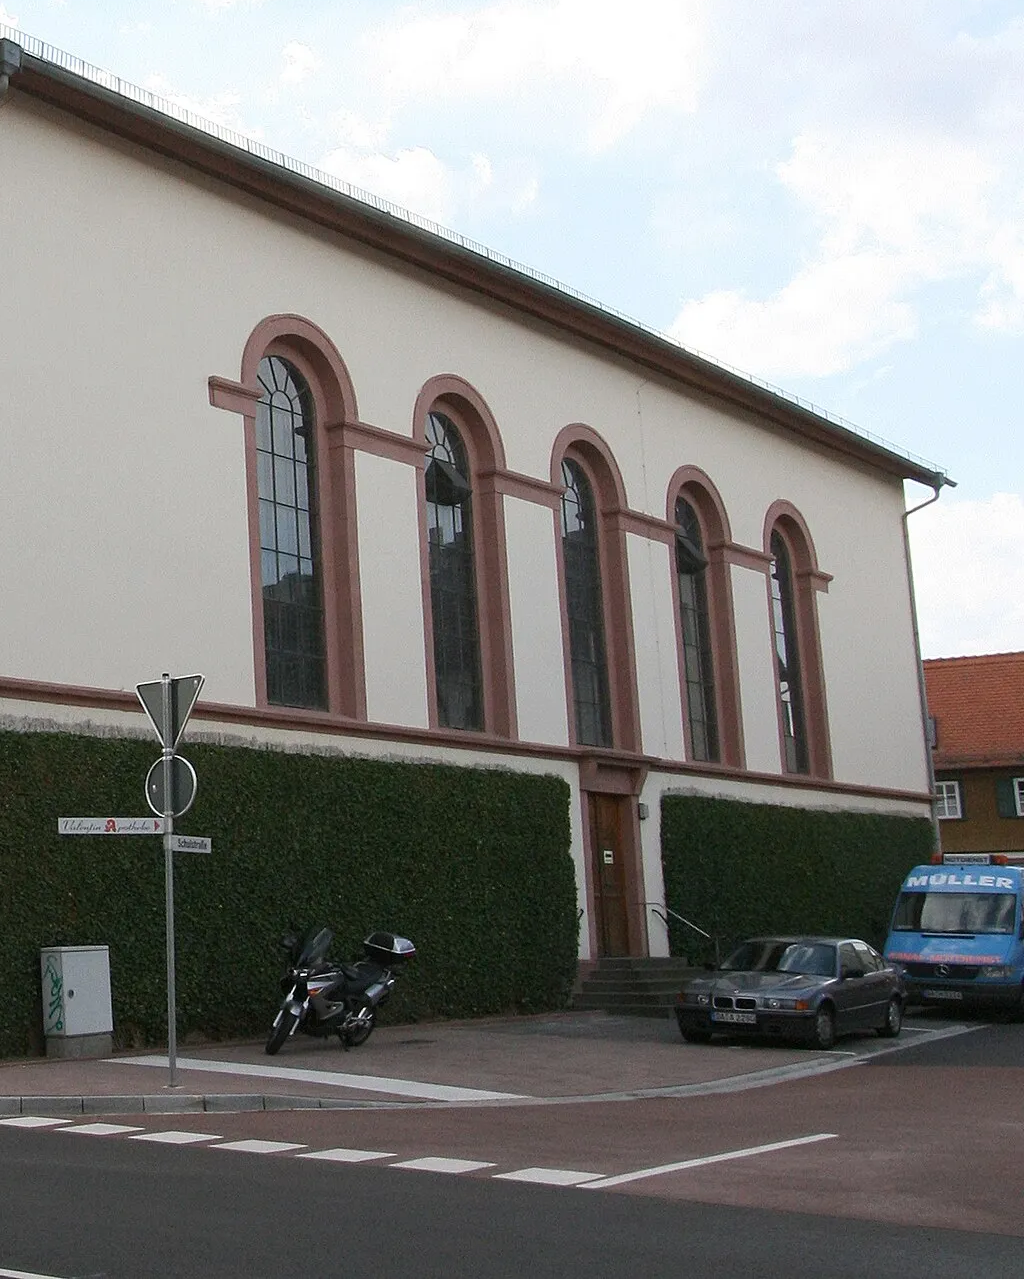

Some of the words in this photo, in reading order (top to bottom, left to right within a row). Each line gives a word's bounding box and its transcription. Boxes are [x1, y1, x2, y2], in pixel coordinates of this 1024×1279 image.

[62, 819, 102, 834] Valentin
[177, 837, 208, 850] Schulstraße
[906, 873, 1014, 889] MÜLLER
